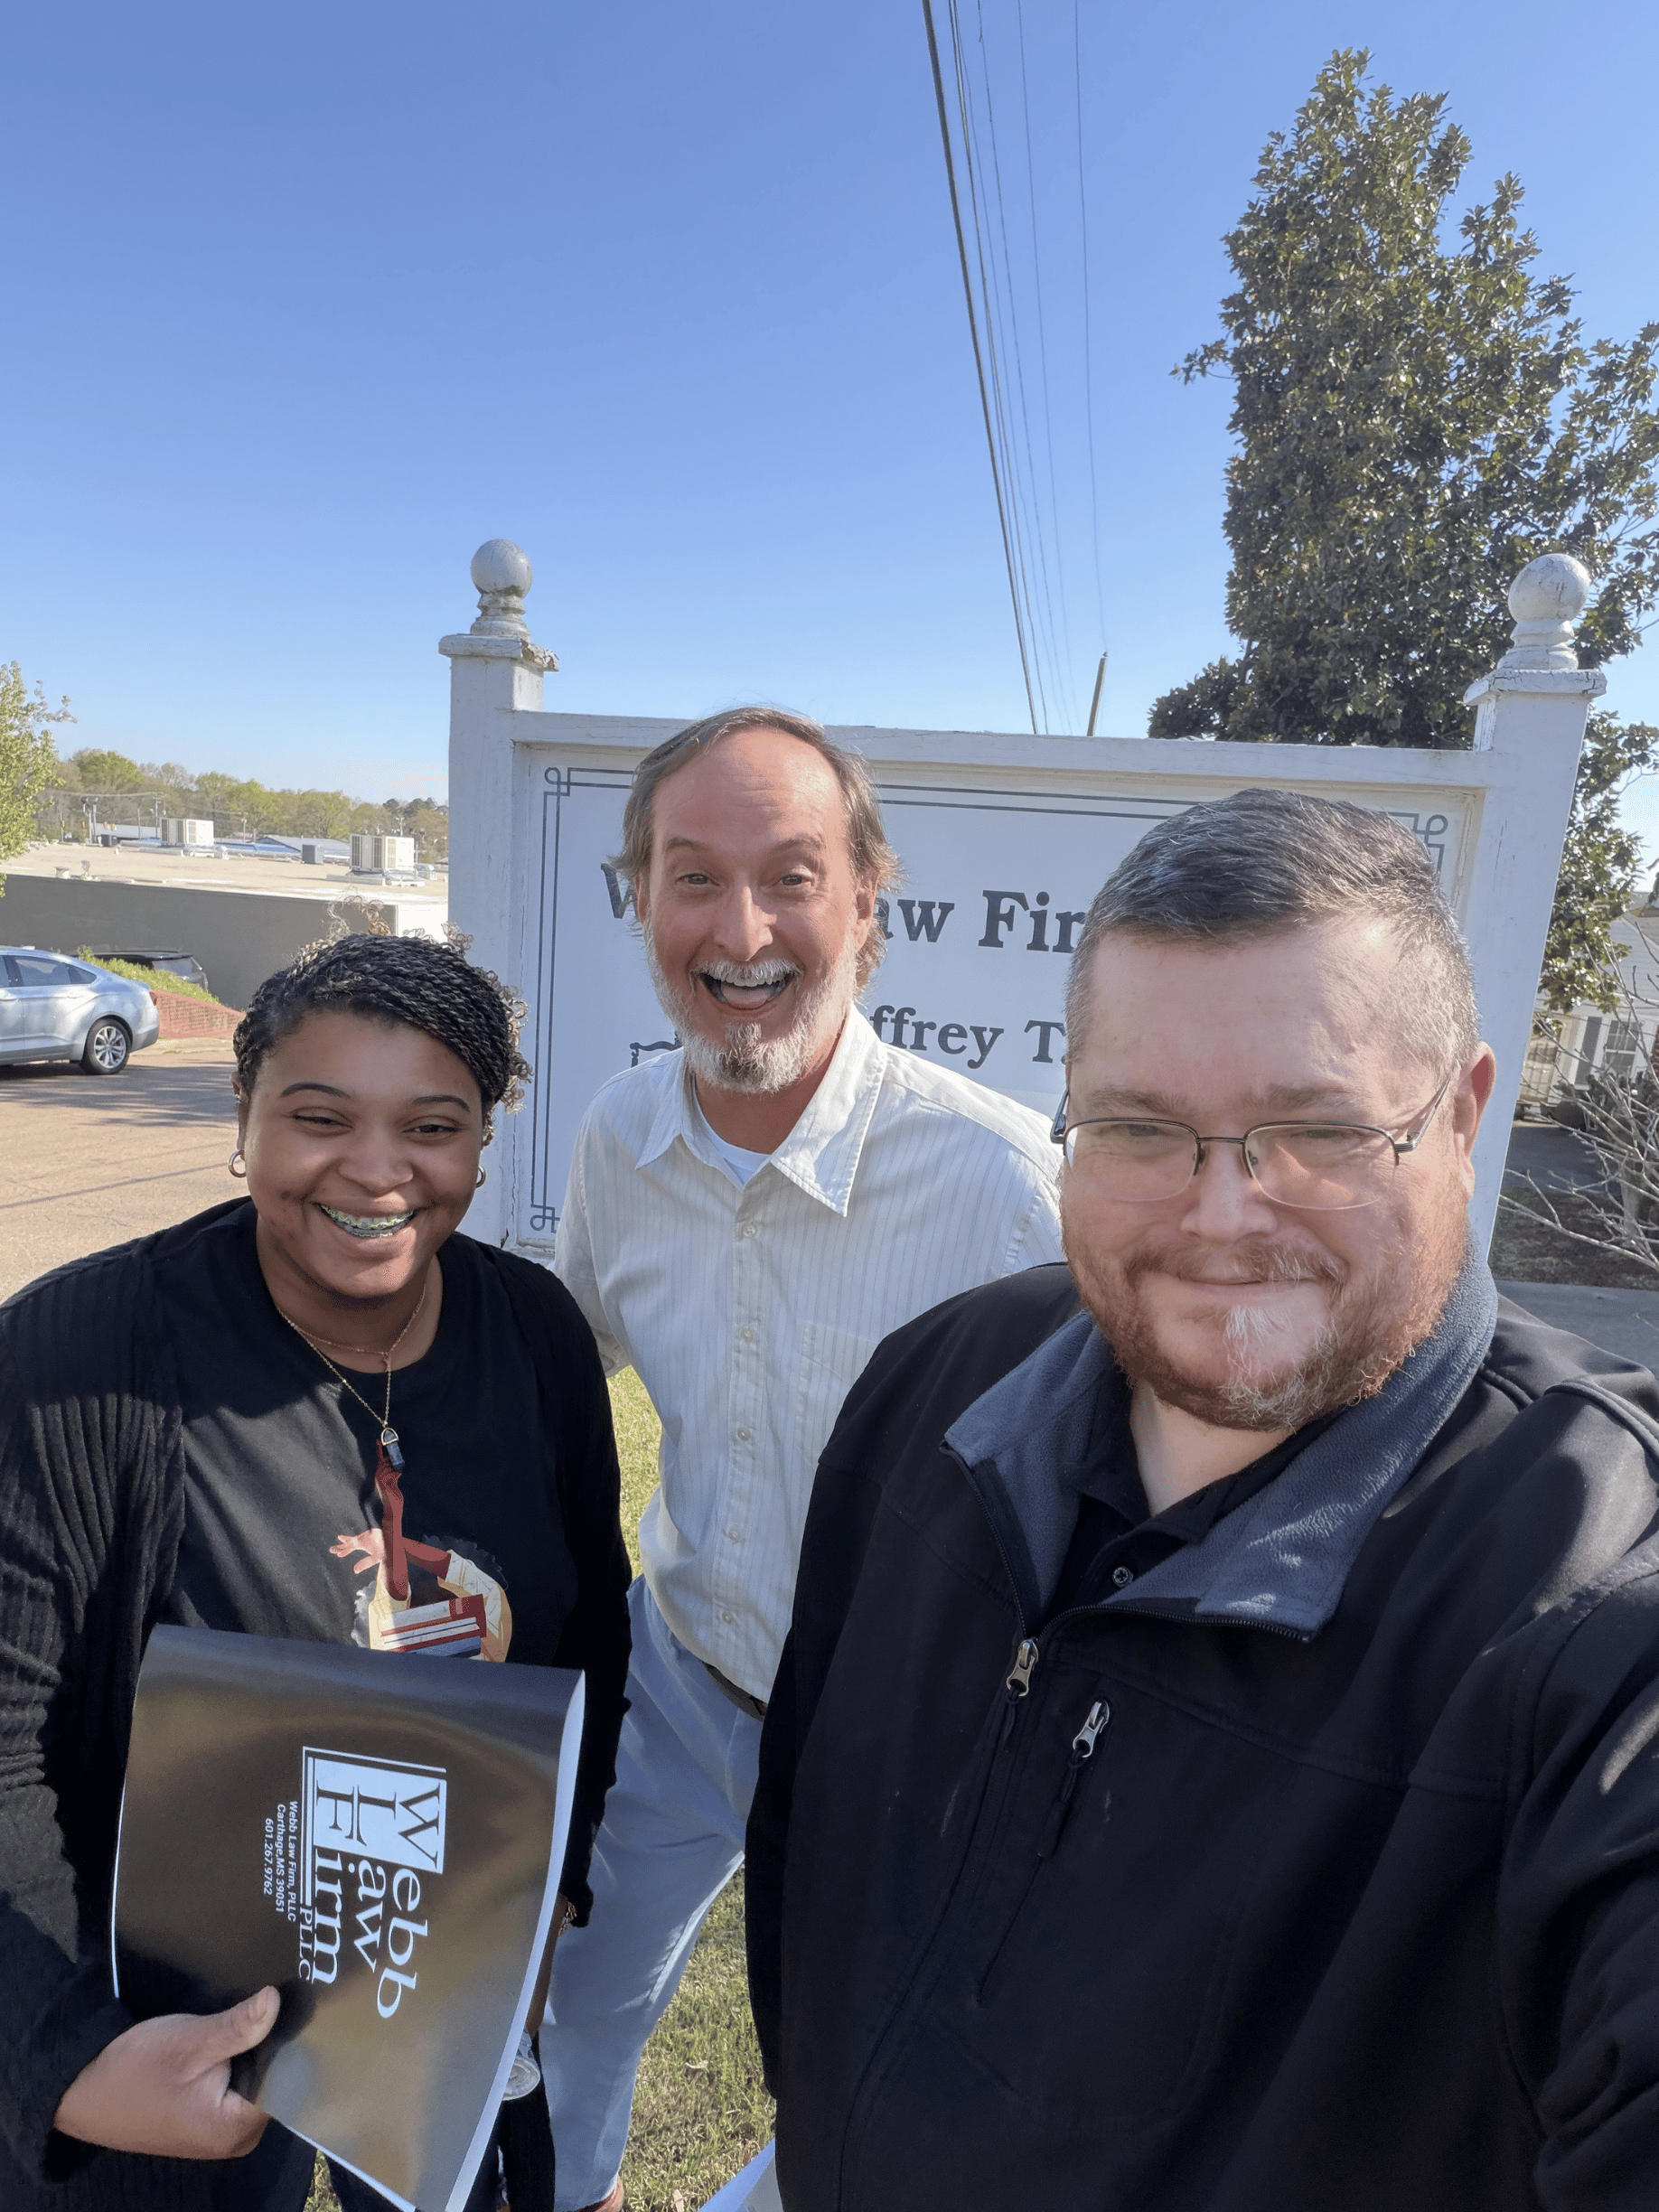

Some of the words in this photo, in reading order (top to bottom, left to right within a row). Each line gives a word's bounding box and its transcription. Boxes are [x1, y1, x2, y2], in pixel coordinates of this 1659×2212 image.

[978, 889, 1086, 953] Fir
[288, 1835, 297, 1859] Law
[289, 1801, 297, 1832] Webb
[264, 1818, 273, 1895] 601.267.9762
[286, 1861, 296, 1889] Firm,
[312, 1780, 356, 1984] Firm
[353, 1785, 397, 1973] Law
[276, 1878, 285, 1913] 39051
[287, 1891, 296, 1922] PLLC
[376, 1781, 441, 2019] Webb
[298, 1907, 313, 1981] PLLC
